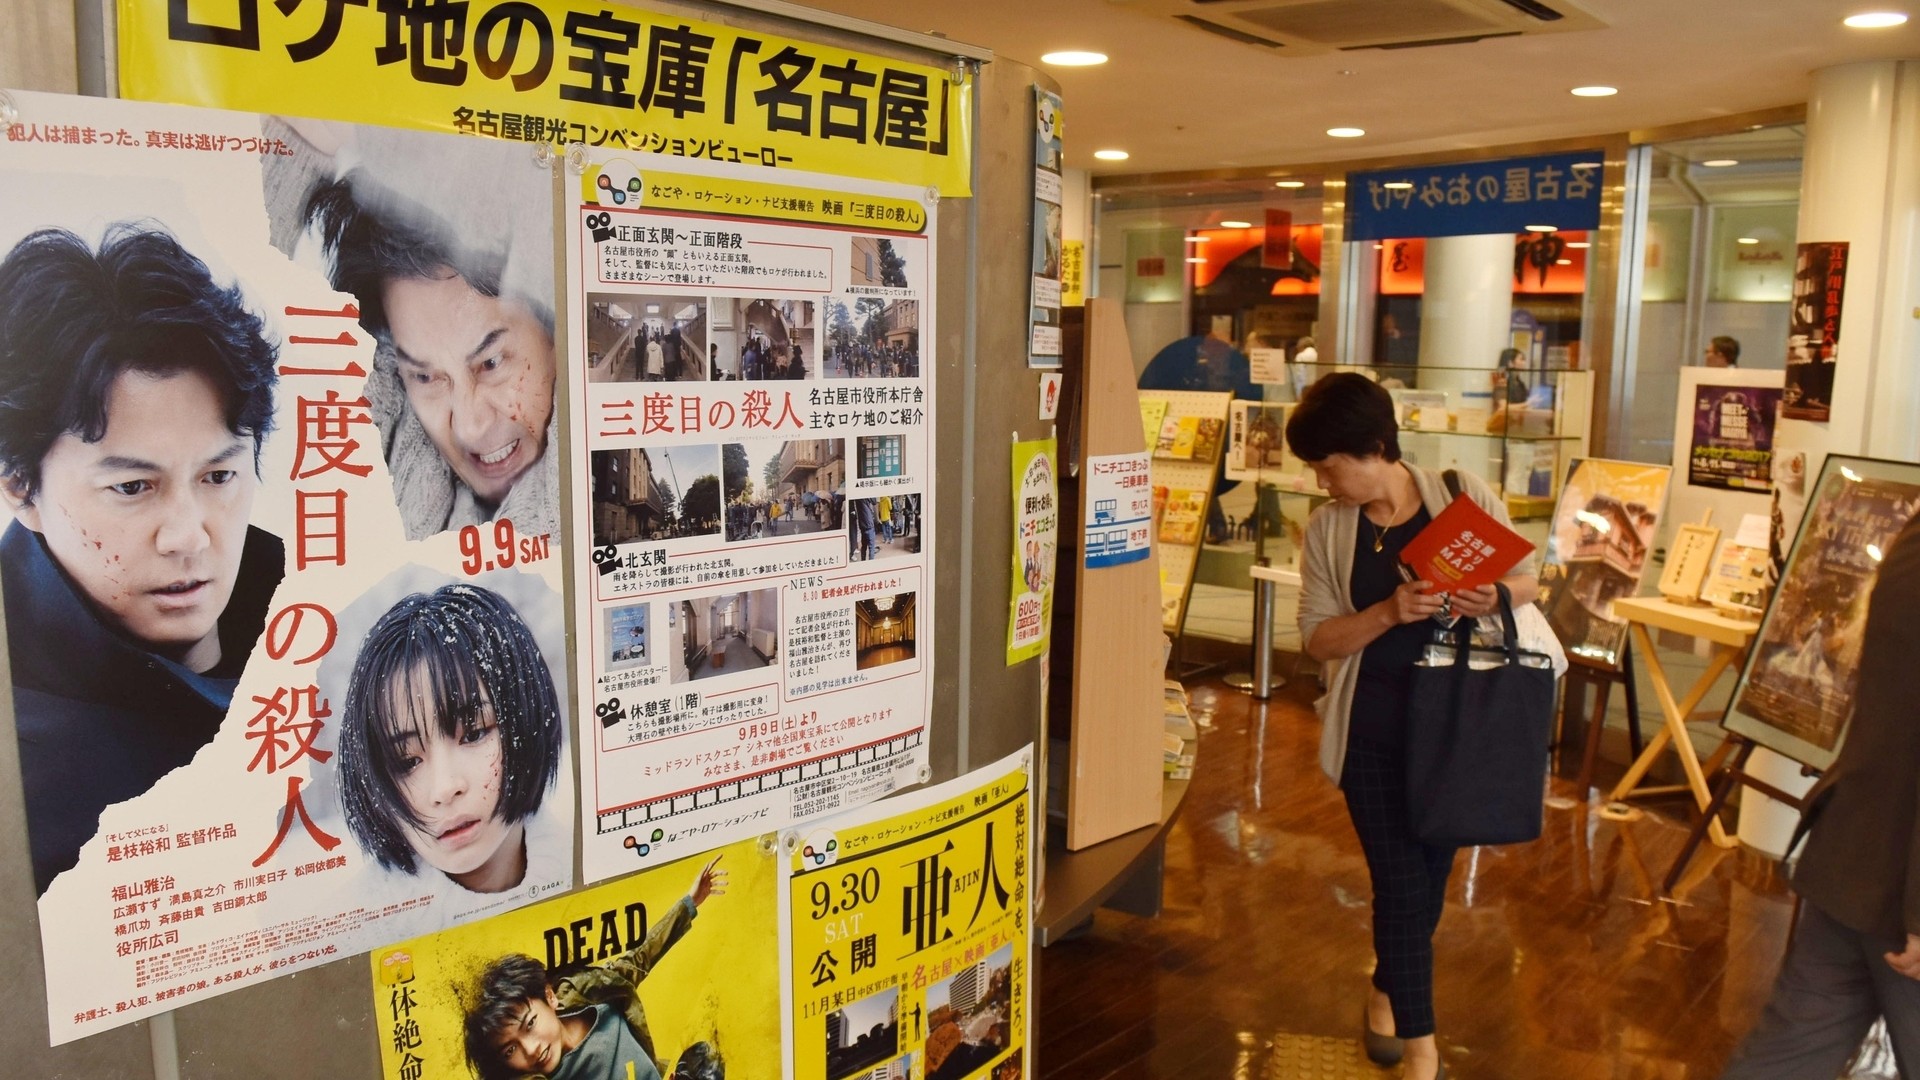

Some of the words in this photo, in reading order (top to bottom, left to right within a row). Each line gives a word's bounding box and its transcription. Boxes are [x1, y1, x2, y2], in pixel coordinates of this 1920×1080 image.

[168, 0, 949, 156] ロケ地の宝庫「名古屋」
[7, 123, 294, 156] 犯人は捕まった。真実は逃げつづけた。
[453, 106, 793, 167] 名古屋観光コンベンションビューロー
[822, 199, 843, 216] 映画
[809, 386, 924, 405] 名古屋市役所本庁舎
[600, 390, 805, 437] 三度目の殺人
[809, 409, 924, 429] 主なロケ地のご紹介
[1131, 500, 1148, 511] 市バス
[458, 517, 516, 576] 9.9
[520, 533, 550, 565] SAT
[1131, 529, 1147, 541] 地下鉄
[625, 549, 666, 568] 北玄関
[1440, 546, 1475, 572] MAP
[245, 303, 374, 868] 三度目の殺人
[790, 576, 823, 590] NEWS
[644, 745, 741, 776] ミッドランドスクエア
[704, 735, 843, 777] みなさま、是非劇場でご覧ください
[107, 837, 171, 862] 是枝裕和
[176, 823, 237, 848] 監督作品
[112, 875, 175, 902] 福山雅治
[113, 897, 161, 919] 広瀬すず
[169, 884, 226, 906] 満島真之介
[233, 869, 288, 890] 市川実日子
[295, 855, 347, 877] 松岡依都美
[811, 867, 880, 920] 9.30
[954, 869, 980, 893] AJIN
[115, 918, 151, 937] 橋爪功
[158, 905, 205, 926] 斉藤由貴
[212, 891, 267, 913] 吉田鋼太郎
[825, 913, 863, 944] SAT
[116, 929, 179, 957] 役所広司
[543, 902, 647, 973] DEAD
[810, 933, 877, 988] 公開
[387, 966, 425, 1080] 体絶命
